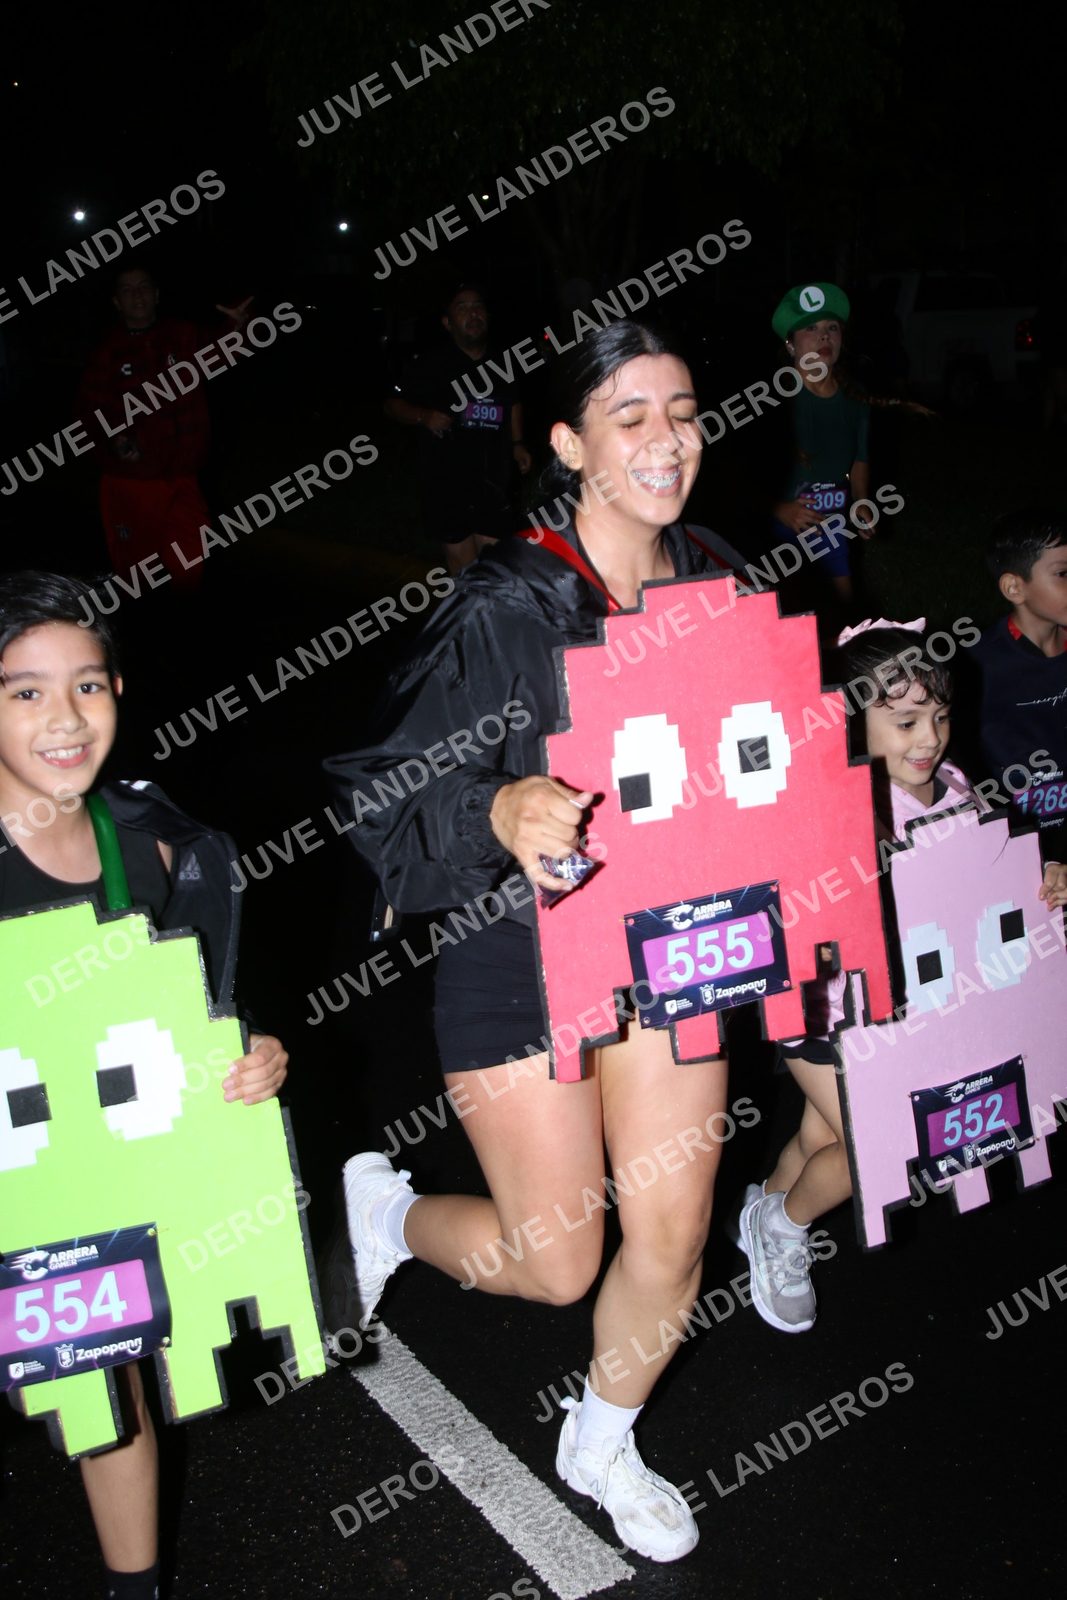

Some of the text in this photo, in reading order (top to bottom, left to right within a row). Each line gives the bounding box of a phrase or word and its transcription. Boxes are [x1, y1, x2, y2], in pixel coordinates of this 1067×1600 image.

[804, 292, 820, 307] L
[472, 404, 497, 421] 390
[806, 490, 845, 511] 309
[666, 922, 754, 984] 555
[944, 1093, 1005, 1146] 552
[15, 1270, 127, 1343] 554
